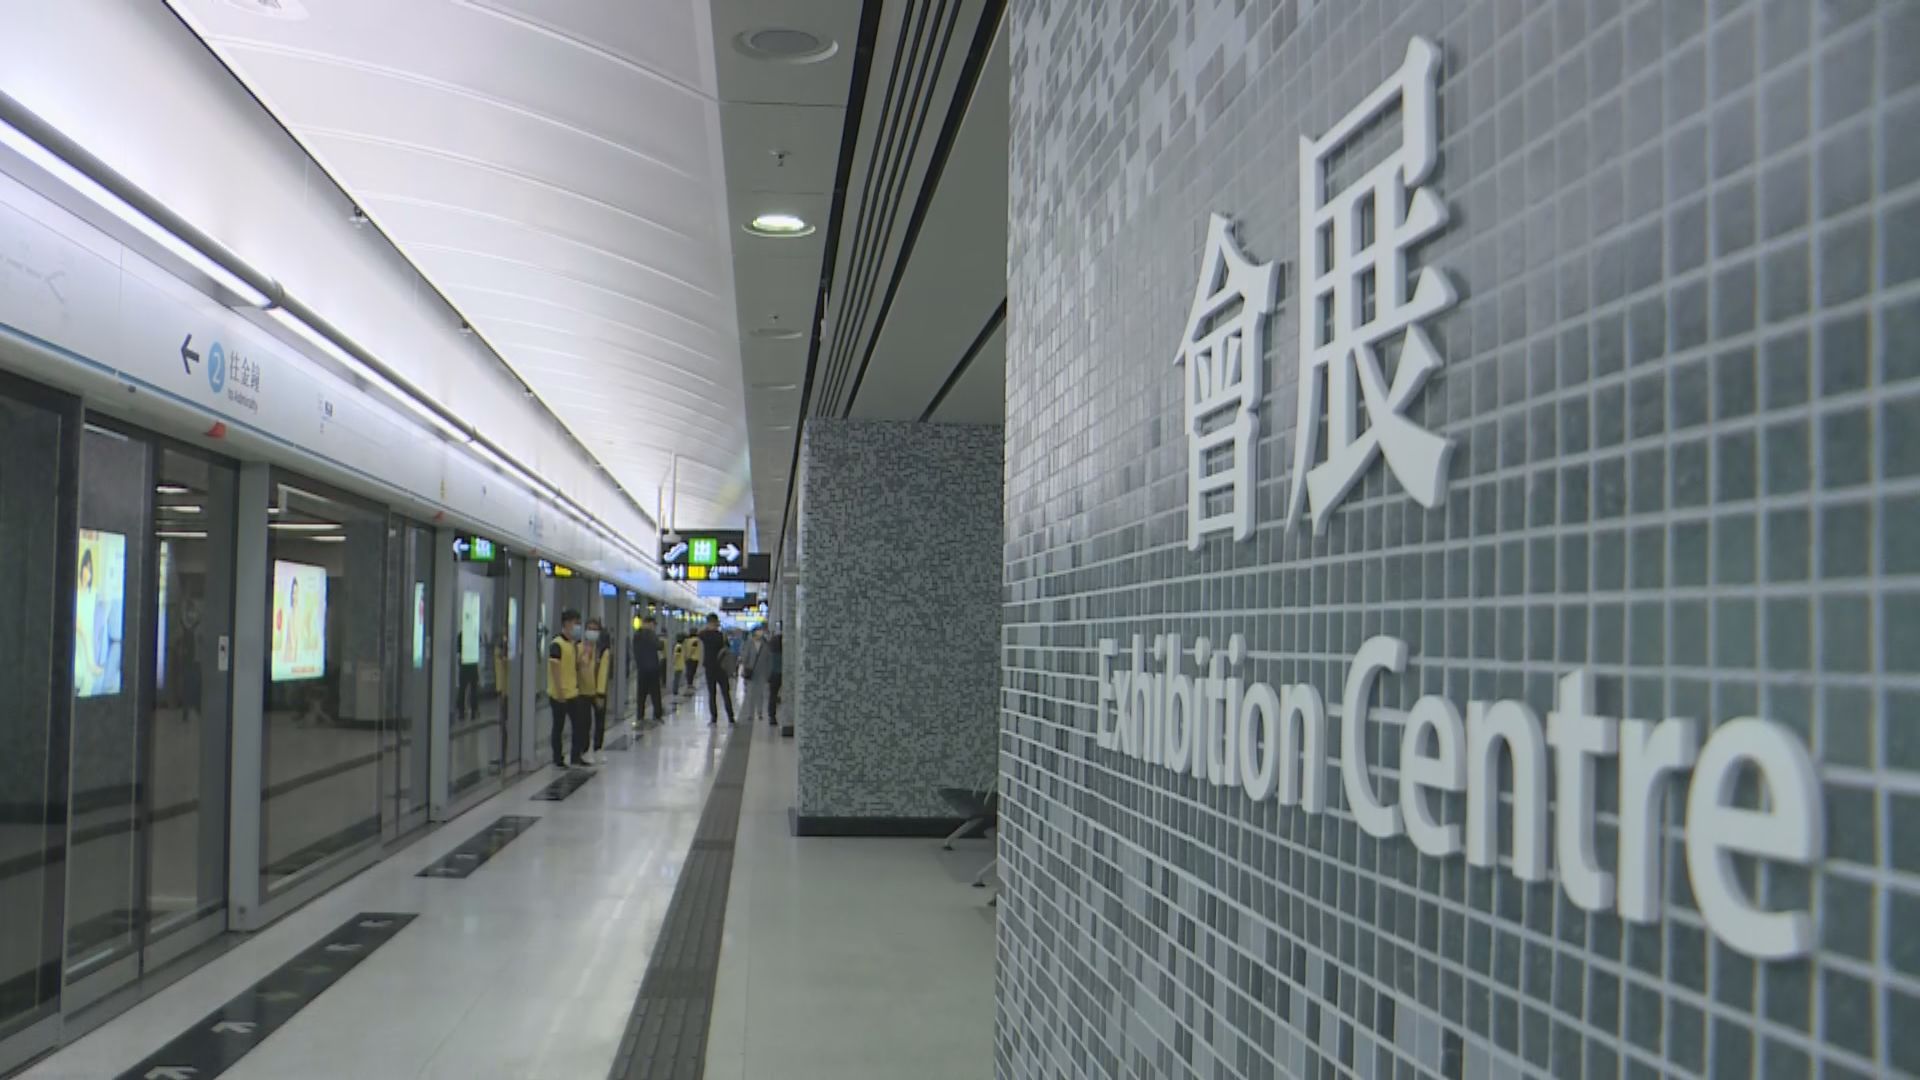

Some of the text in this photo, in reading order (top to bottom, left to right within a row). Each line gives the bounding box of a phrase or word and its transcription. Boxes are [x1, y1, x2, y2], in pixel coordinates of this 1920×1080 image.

[1175, 36, 1460, 552] 會展
[1094, 632, 1826, 961] Exhibition Centre
